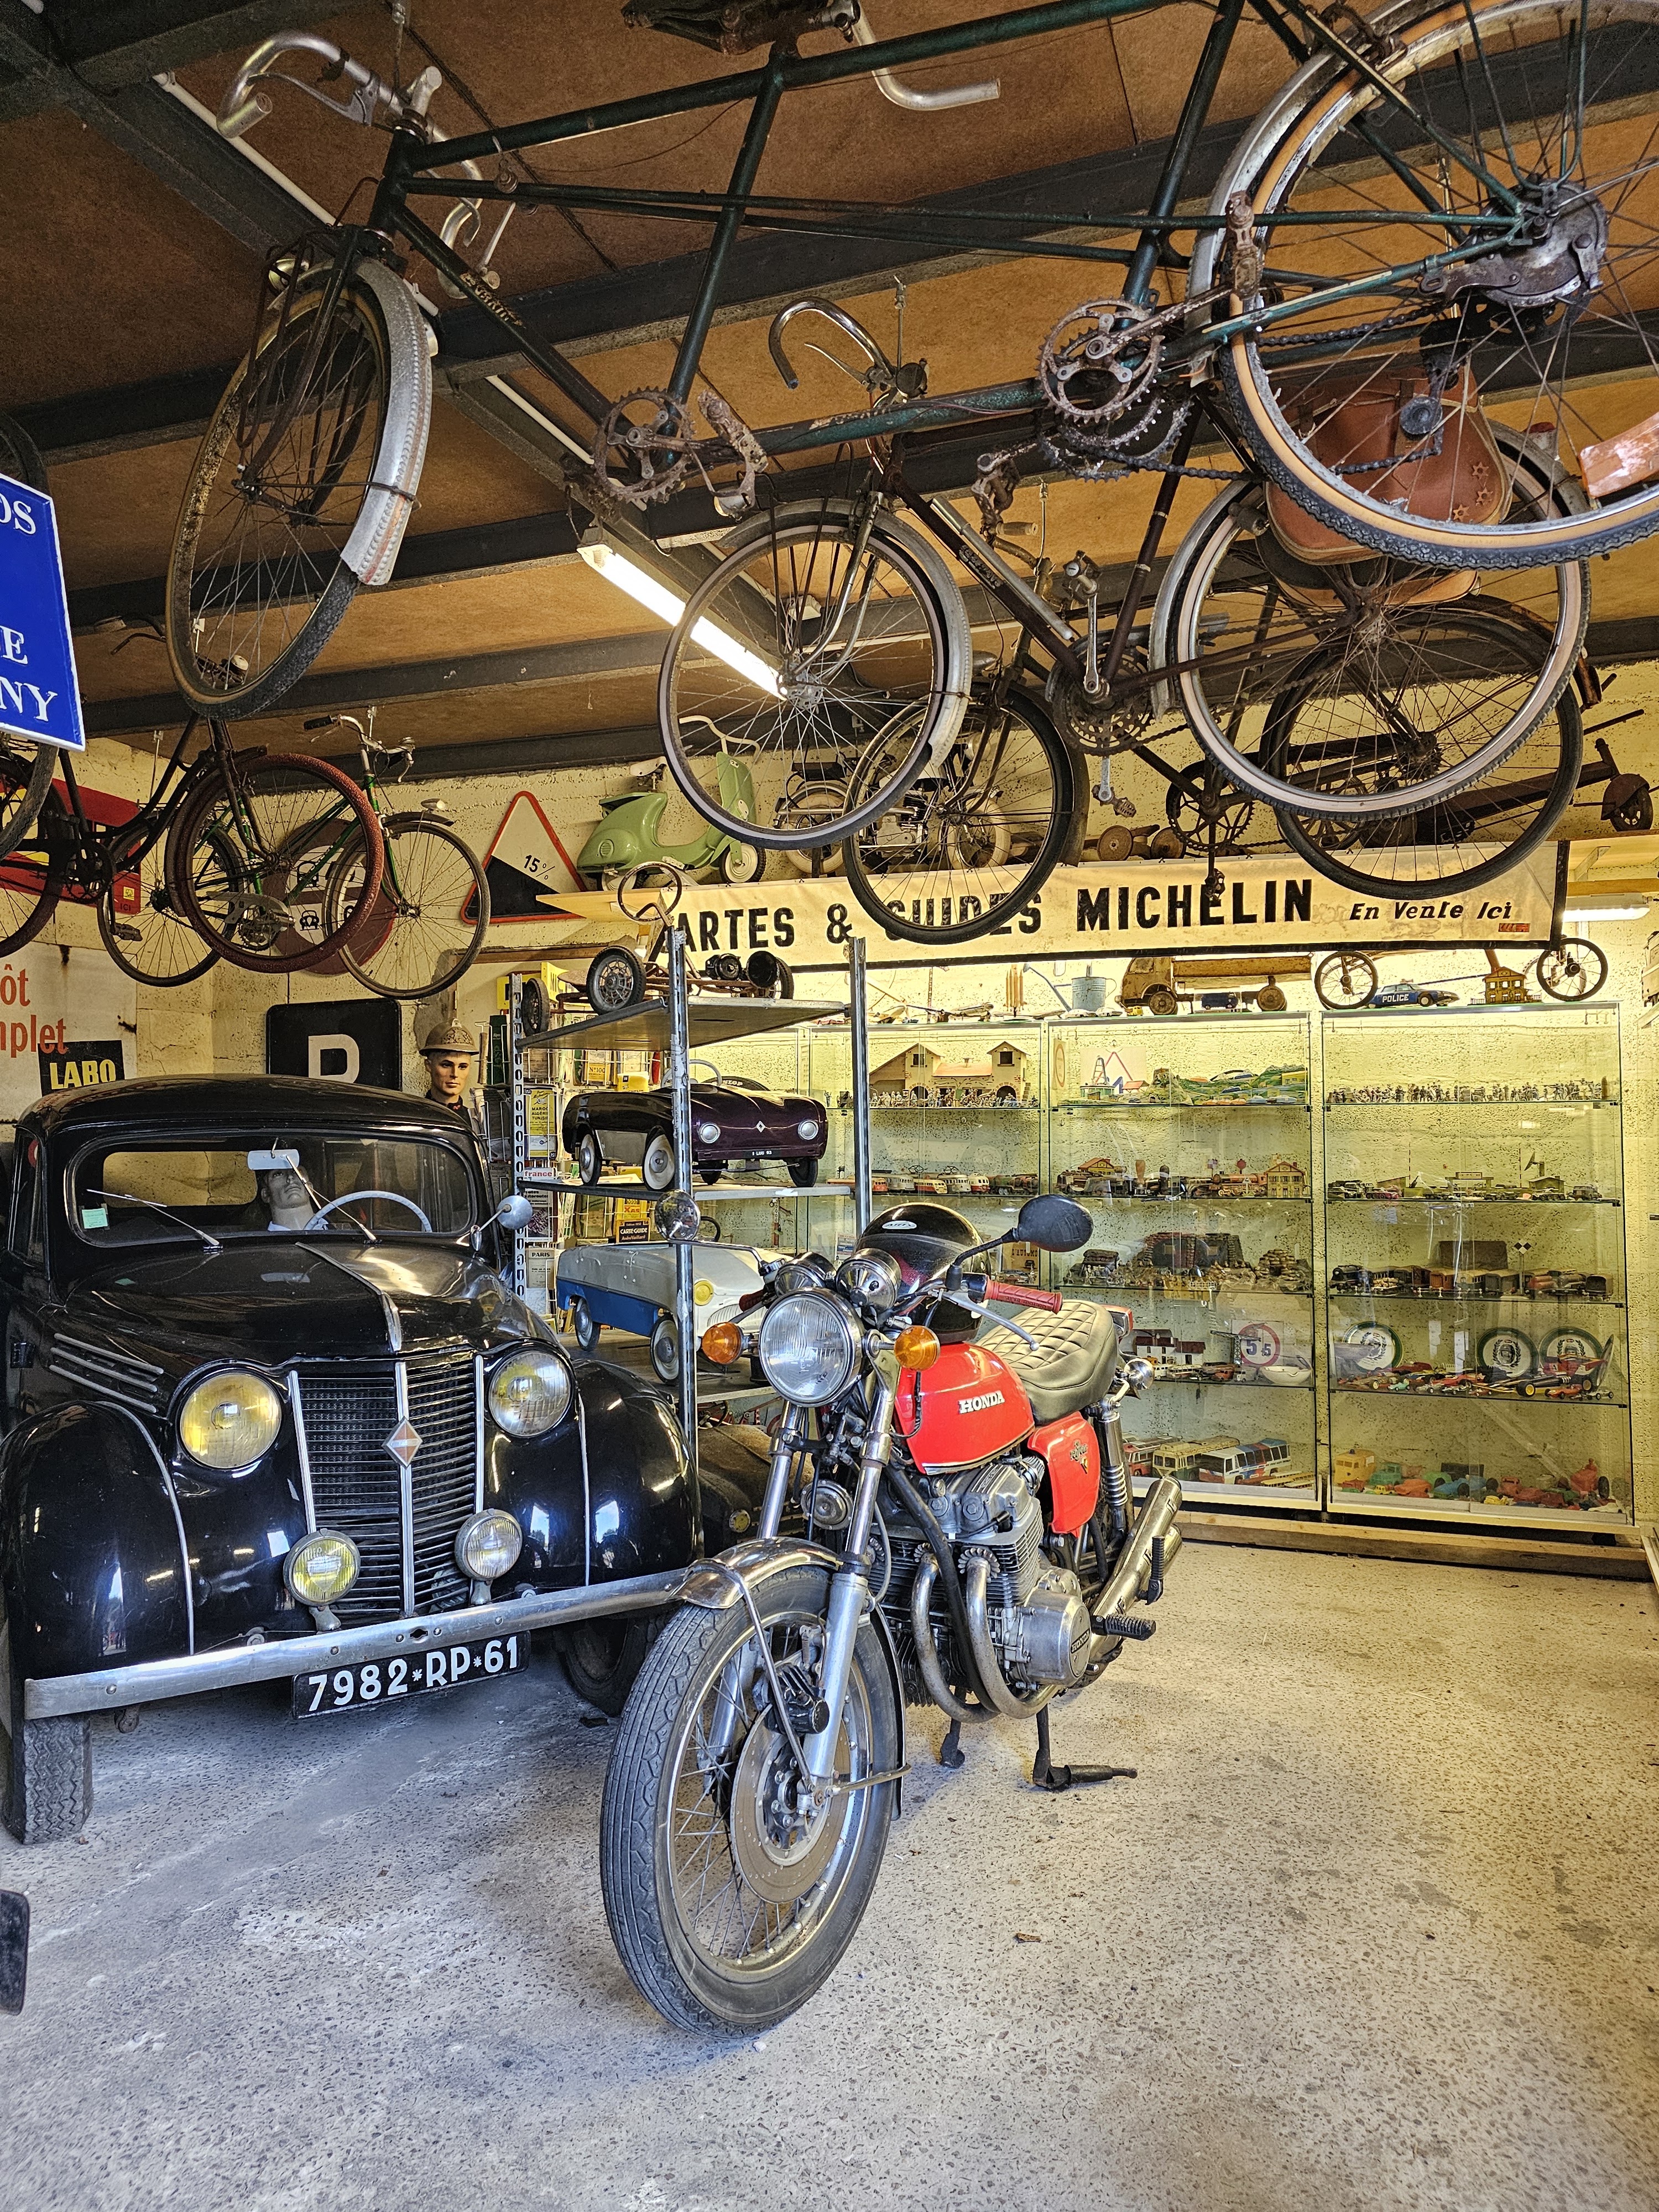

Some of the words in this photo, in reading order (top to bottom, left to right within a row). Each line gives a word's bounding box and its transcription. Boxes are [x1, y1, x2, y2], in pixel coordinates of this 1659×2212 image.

[120, 903, 131, 911] ICI
[662, 907, 795, 953] ARTES
[826, 903, 852, 944] &
[1077, 879, 1312, 932] MICHELIN
[1349, 902, 1379, 920] En
[1394, 901, 1464, 919] Vente
[1477, 901, 1512, 919] Ici
[1382, 994, 1409, 1003] POLICE
[50, 1059, 116, 1090] LABO
[958, 1390, 1005, 1414] HONDA
[1071, 1629, 1091, 1653] HONDA
[309, 1658, 408, 1712] 7982
[426, 1646, 471, 1688] RP
[484, 1636, 518, 1673] 61
